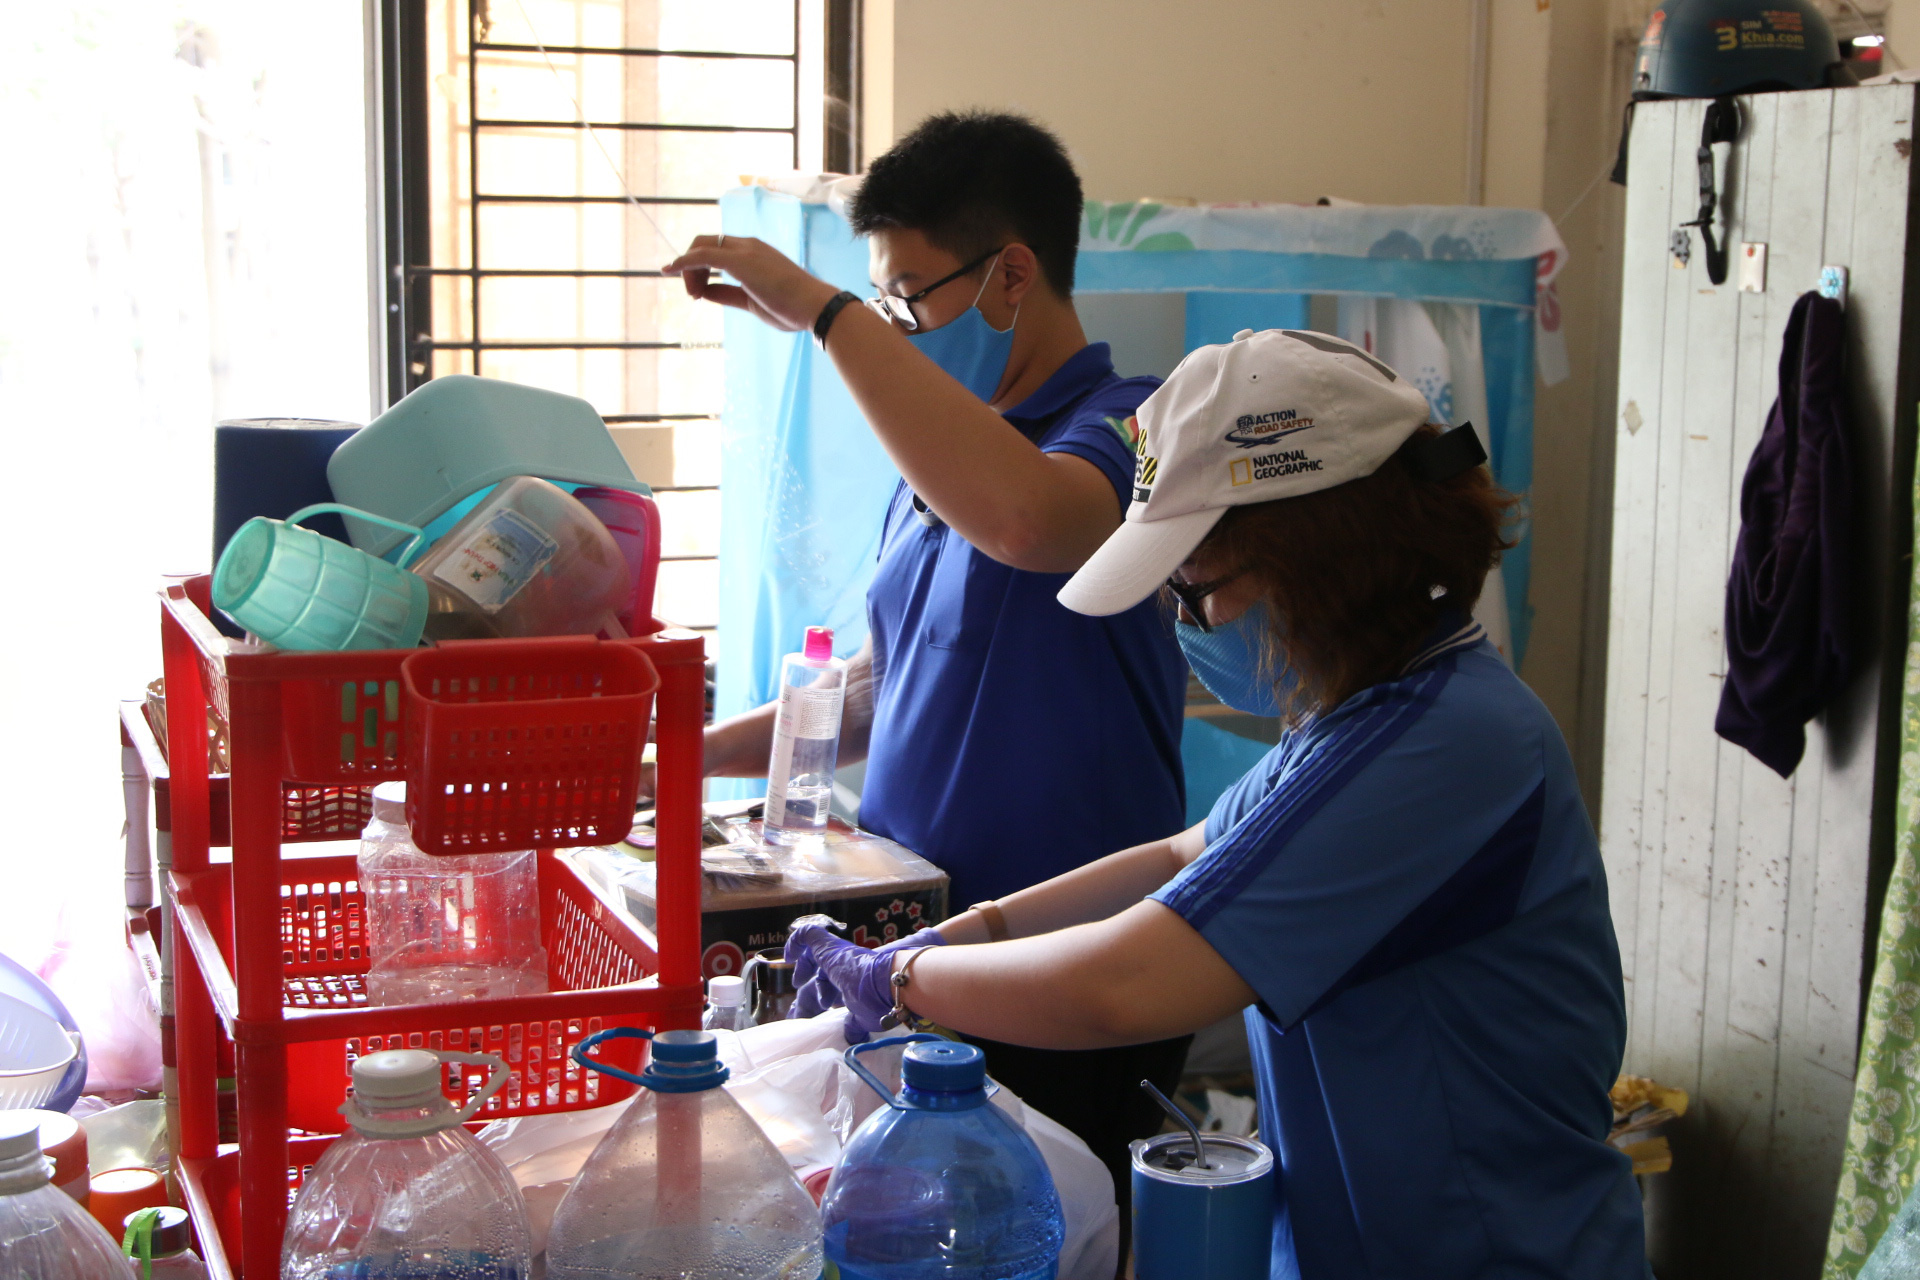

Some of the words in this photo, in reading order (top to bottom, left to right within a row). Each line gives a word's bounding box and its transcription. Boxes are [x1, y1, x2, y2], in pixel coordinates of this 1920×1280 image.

[1715, 26, 1738, 50] 3
[1255, 409, 1296, 425] ACTION
[1241, 427, 1253, 436] FOR
[1254, 423, 1280, 435] ROAD
[1280, 418, 1314, 430] SAFETY
[1253, 450, 1308, 468] NATIONAL
[1254, 460, 1323, 480] GEOGRAPHIC
